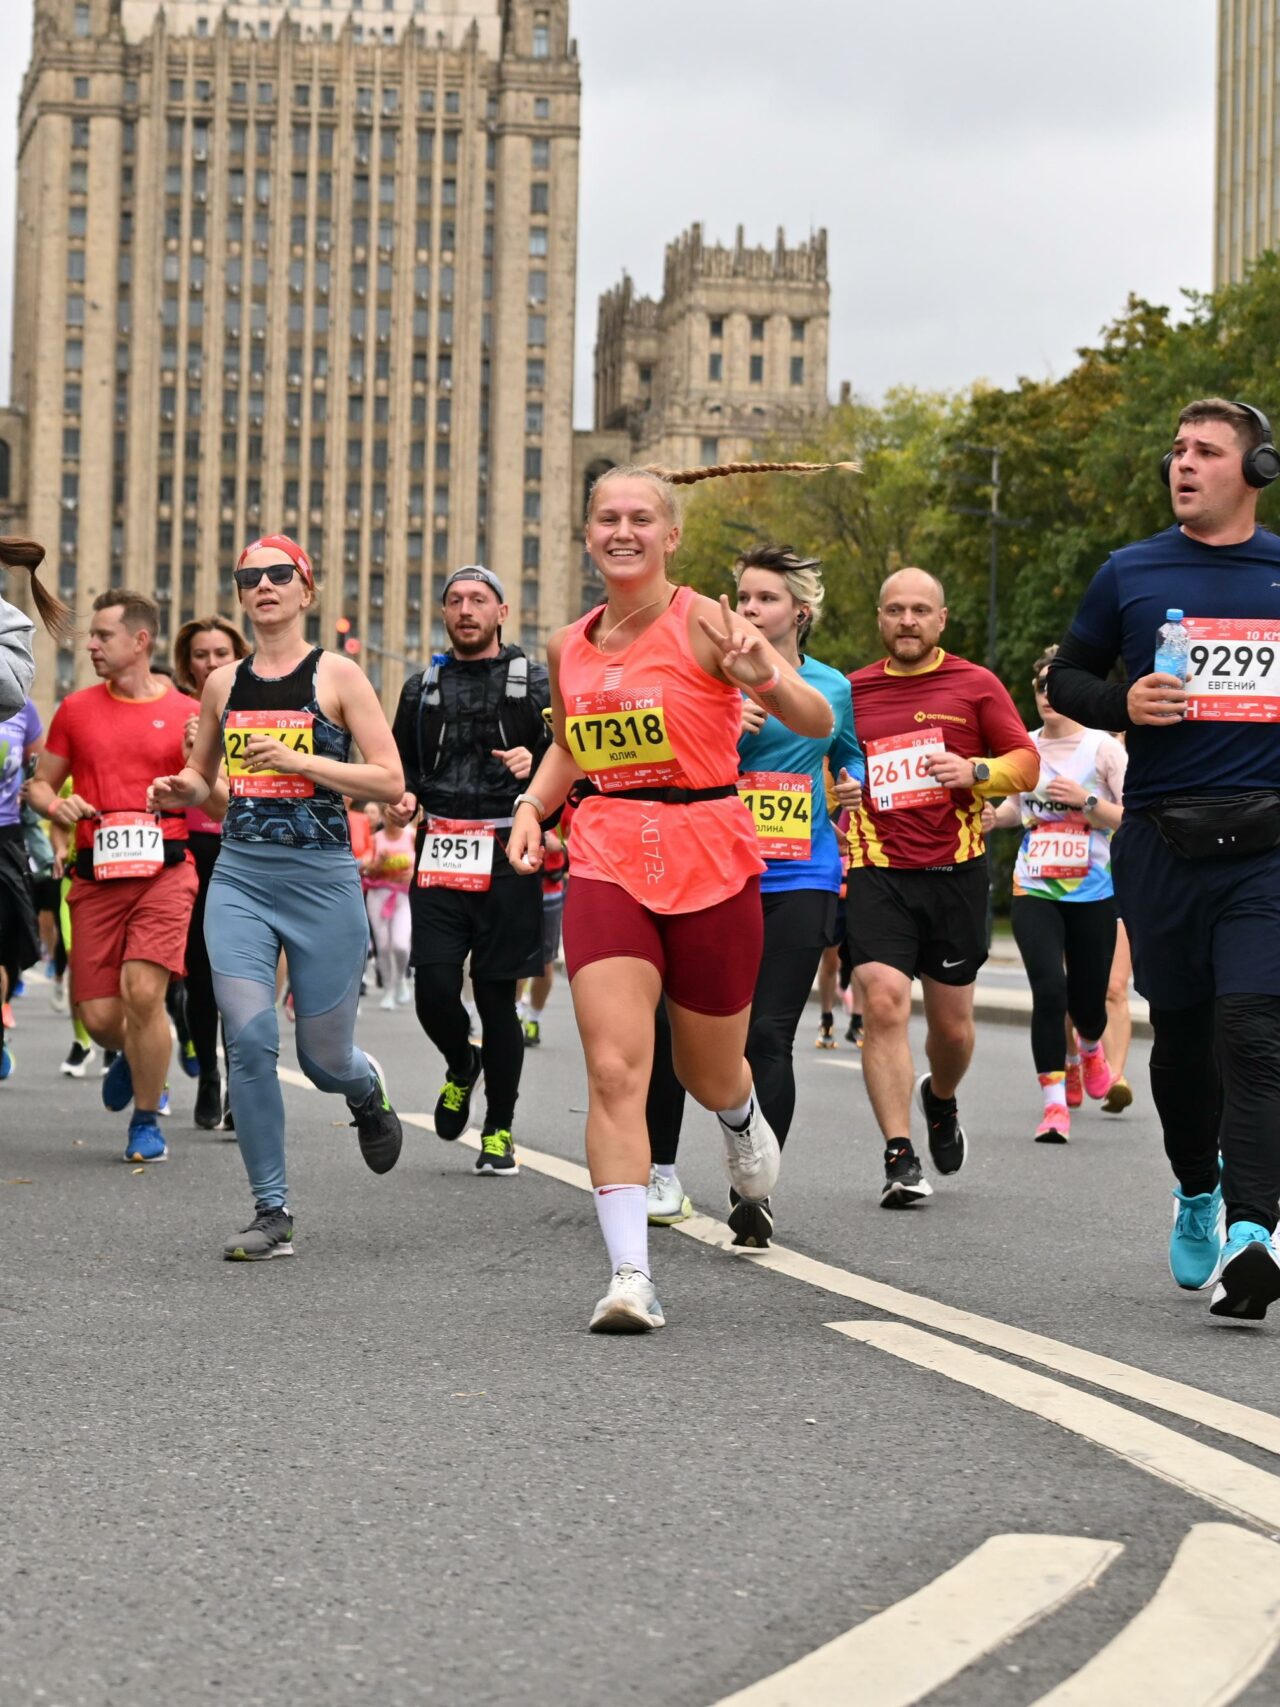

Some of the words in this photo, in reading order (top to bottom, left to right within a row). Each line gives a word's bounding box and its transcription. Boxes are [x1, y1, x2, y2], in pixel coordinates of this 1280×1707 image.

[1246, 631, 1260, 640] 10
[1190, 645, 1275, 677] 9299
[1207, 680, 1256, 691] ЕВГЕНИЙ
[619, 701, 632, 711] 10
[570, 714, 664, 752] 17318
[609, 750, 637, 762] ЮЛИЯ
[778, 783, 790, 791] 10
[96, 829, 160, 852] 18117
[431, 838, 480, 861] 5951
[1029, 840, 1086, 858] 27105
